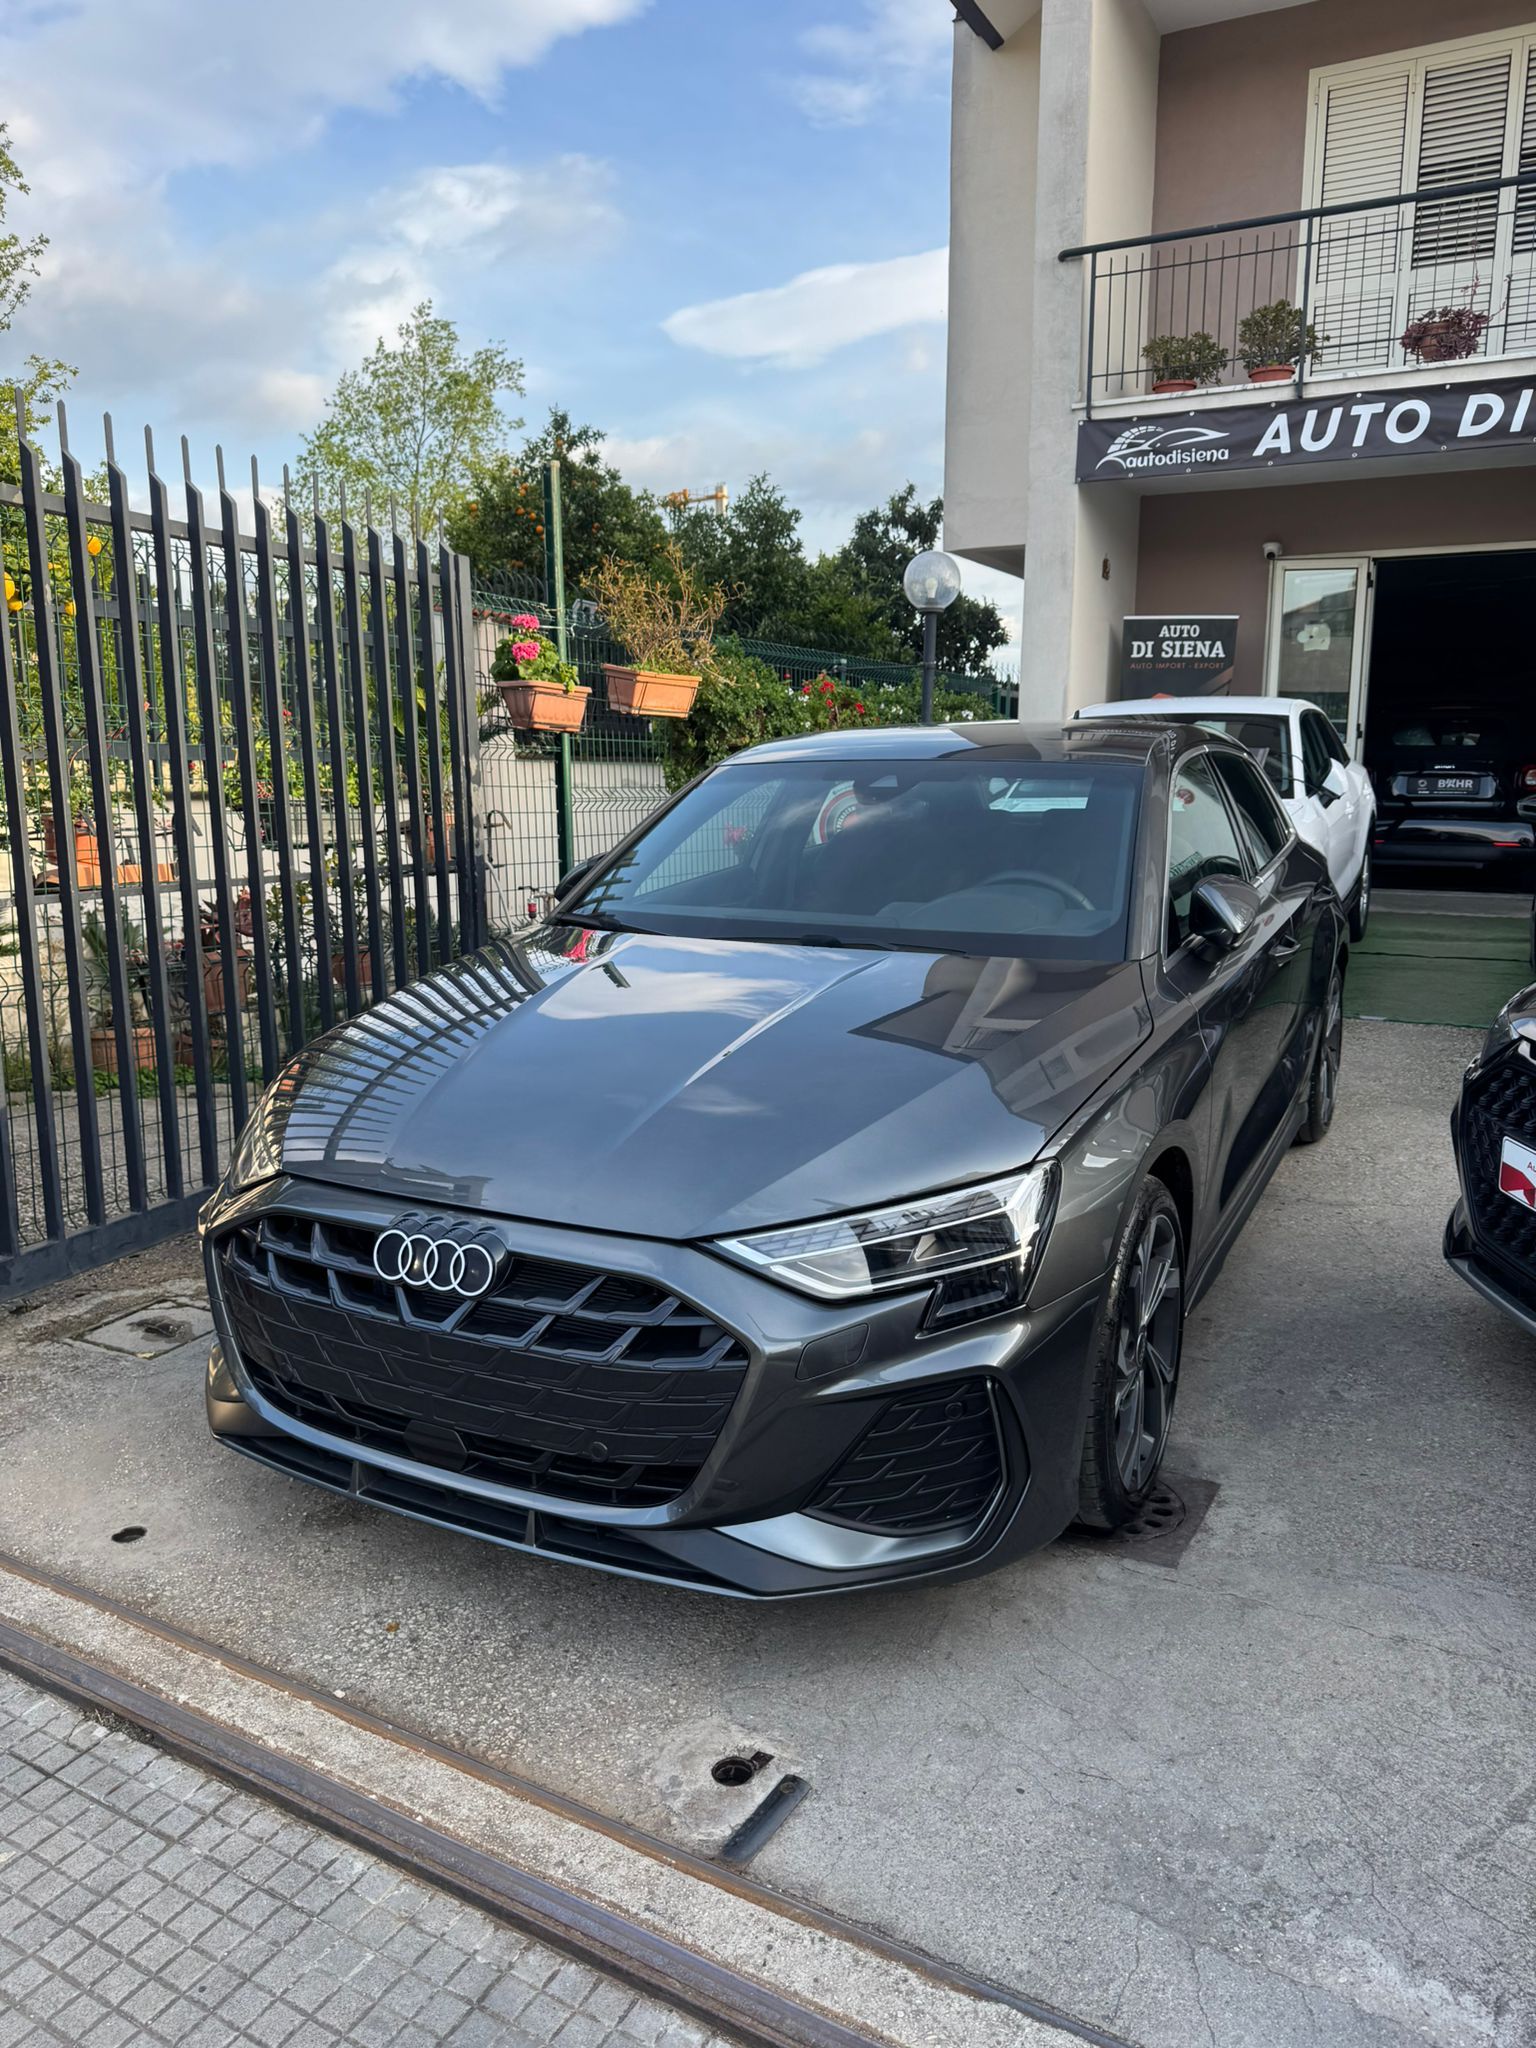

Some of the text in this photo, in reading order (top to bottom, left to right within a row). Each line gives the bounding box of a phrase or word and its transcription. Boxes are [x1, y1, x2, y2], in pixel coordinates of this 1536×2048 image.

[1252, 389, 1534, 457] AUTO DI
[1126, 448, 1229, 468] autodisiena
[1158, 625, 1200, 638] AUTO
[1130, 641, 1225, 658] DI SIENA
